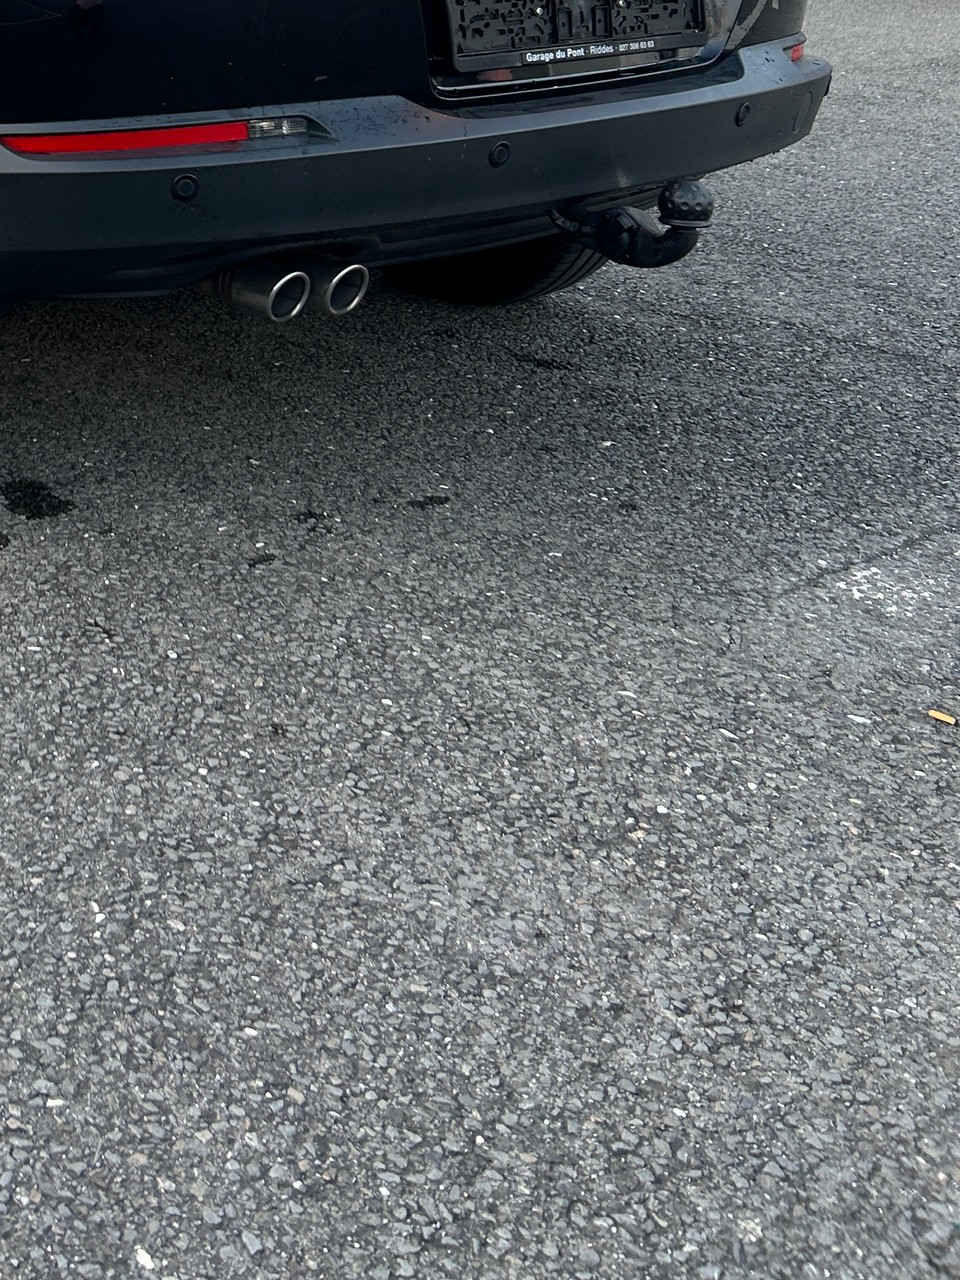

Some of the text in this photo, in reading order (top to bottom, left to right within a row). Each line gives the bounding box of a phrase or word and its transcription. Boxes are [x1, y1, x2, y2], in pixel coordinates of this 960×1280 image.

[526, 52, 554, 63] Garage
[556, 49, 566, 58] du
[567, 47, 585, 57] Pont
[590, 45, 614, 55] Riddes
